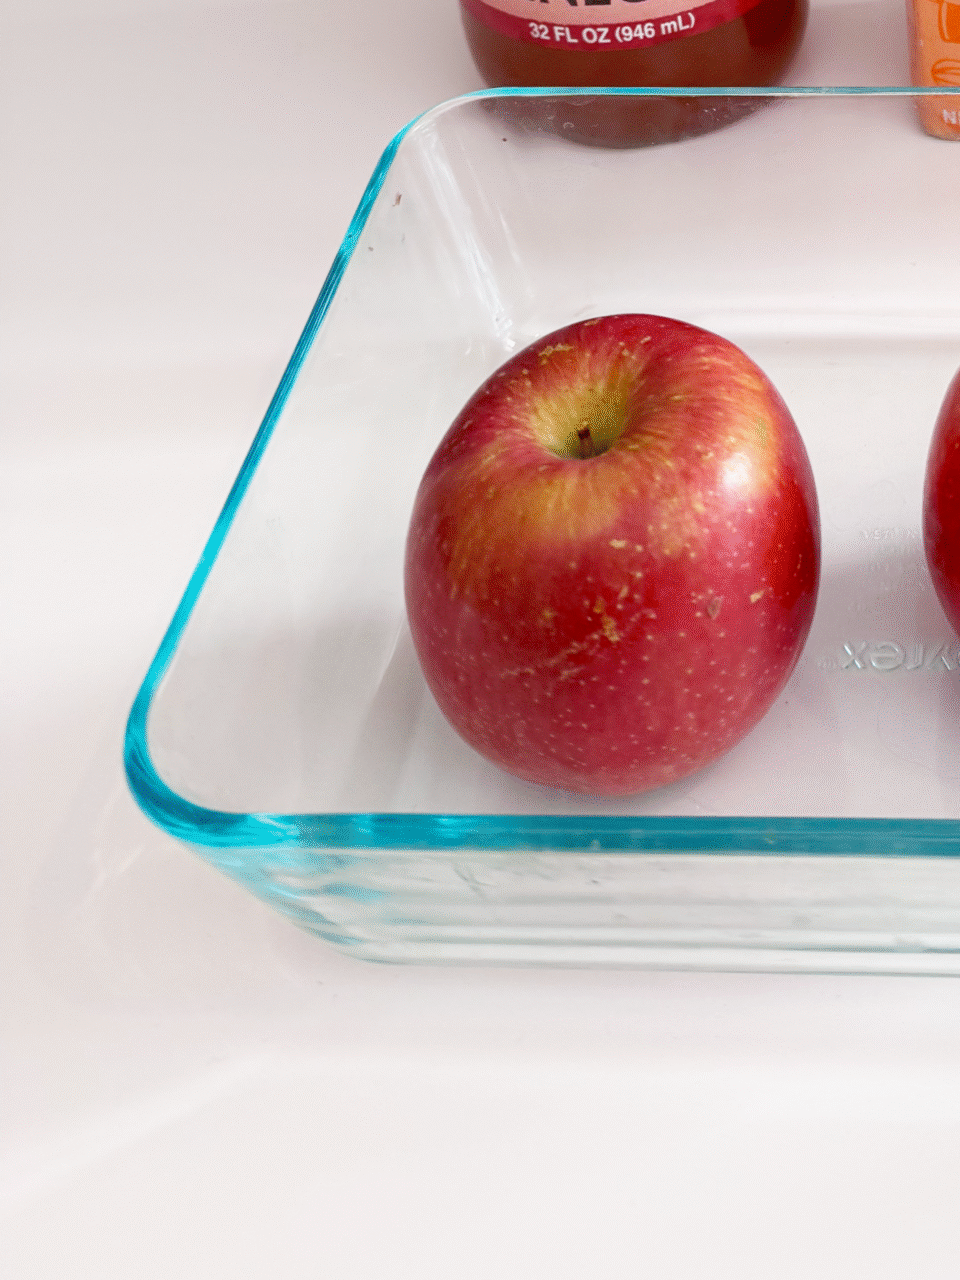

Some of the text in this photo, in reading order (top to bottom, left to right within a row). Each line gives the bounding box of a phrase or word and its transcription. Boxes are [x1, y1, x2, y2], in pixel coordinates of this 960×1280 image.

[528, 12, 695, 44] 32 FL OZ (946 mL)
